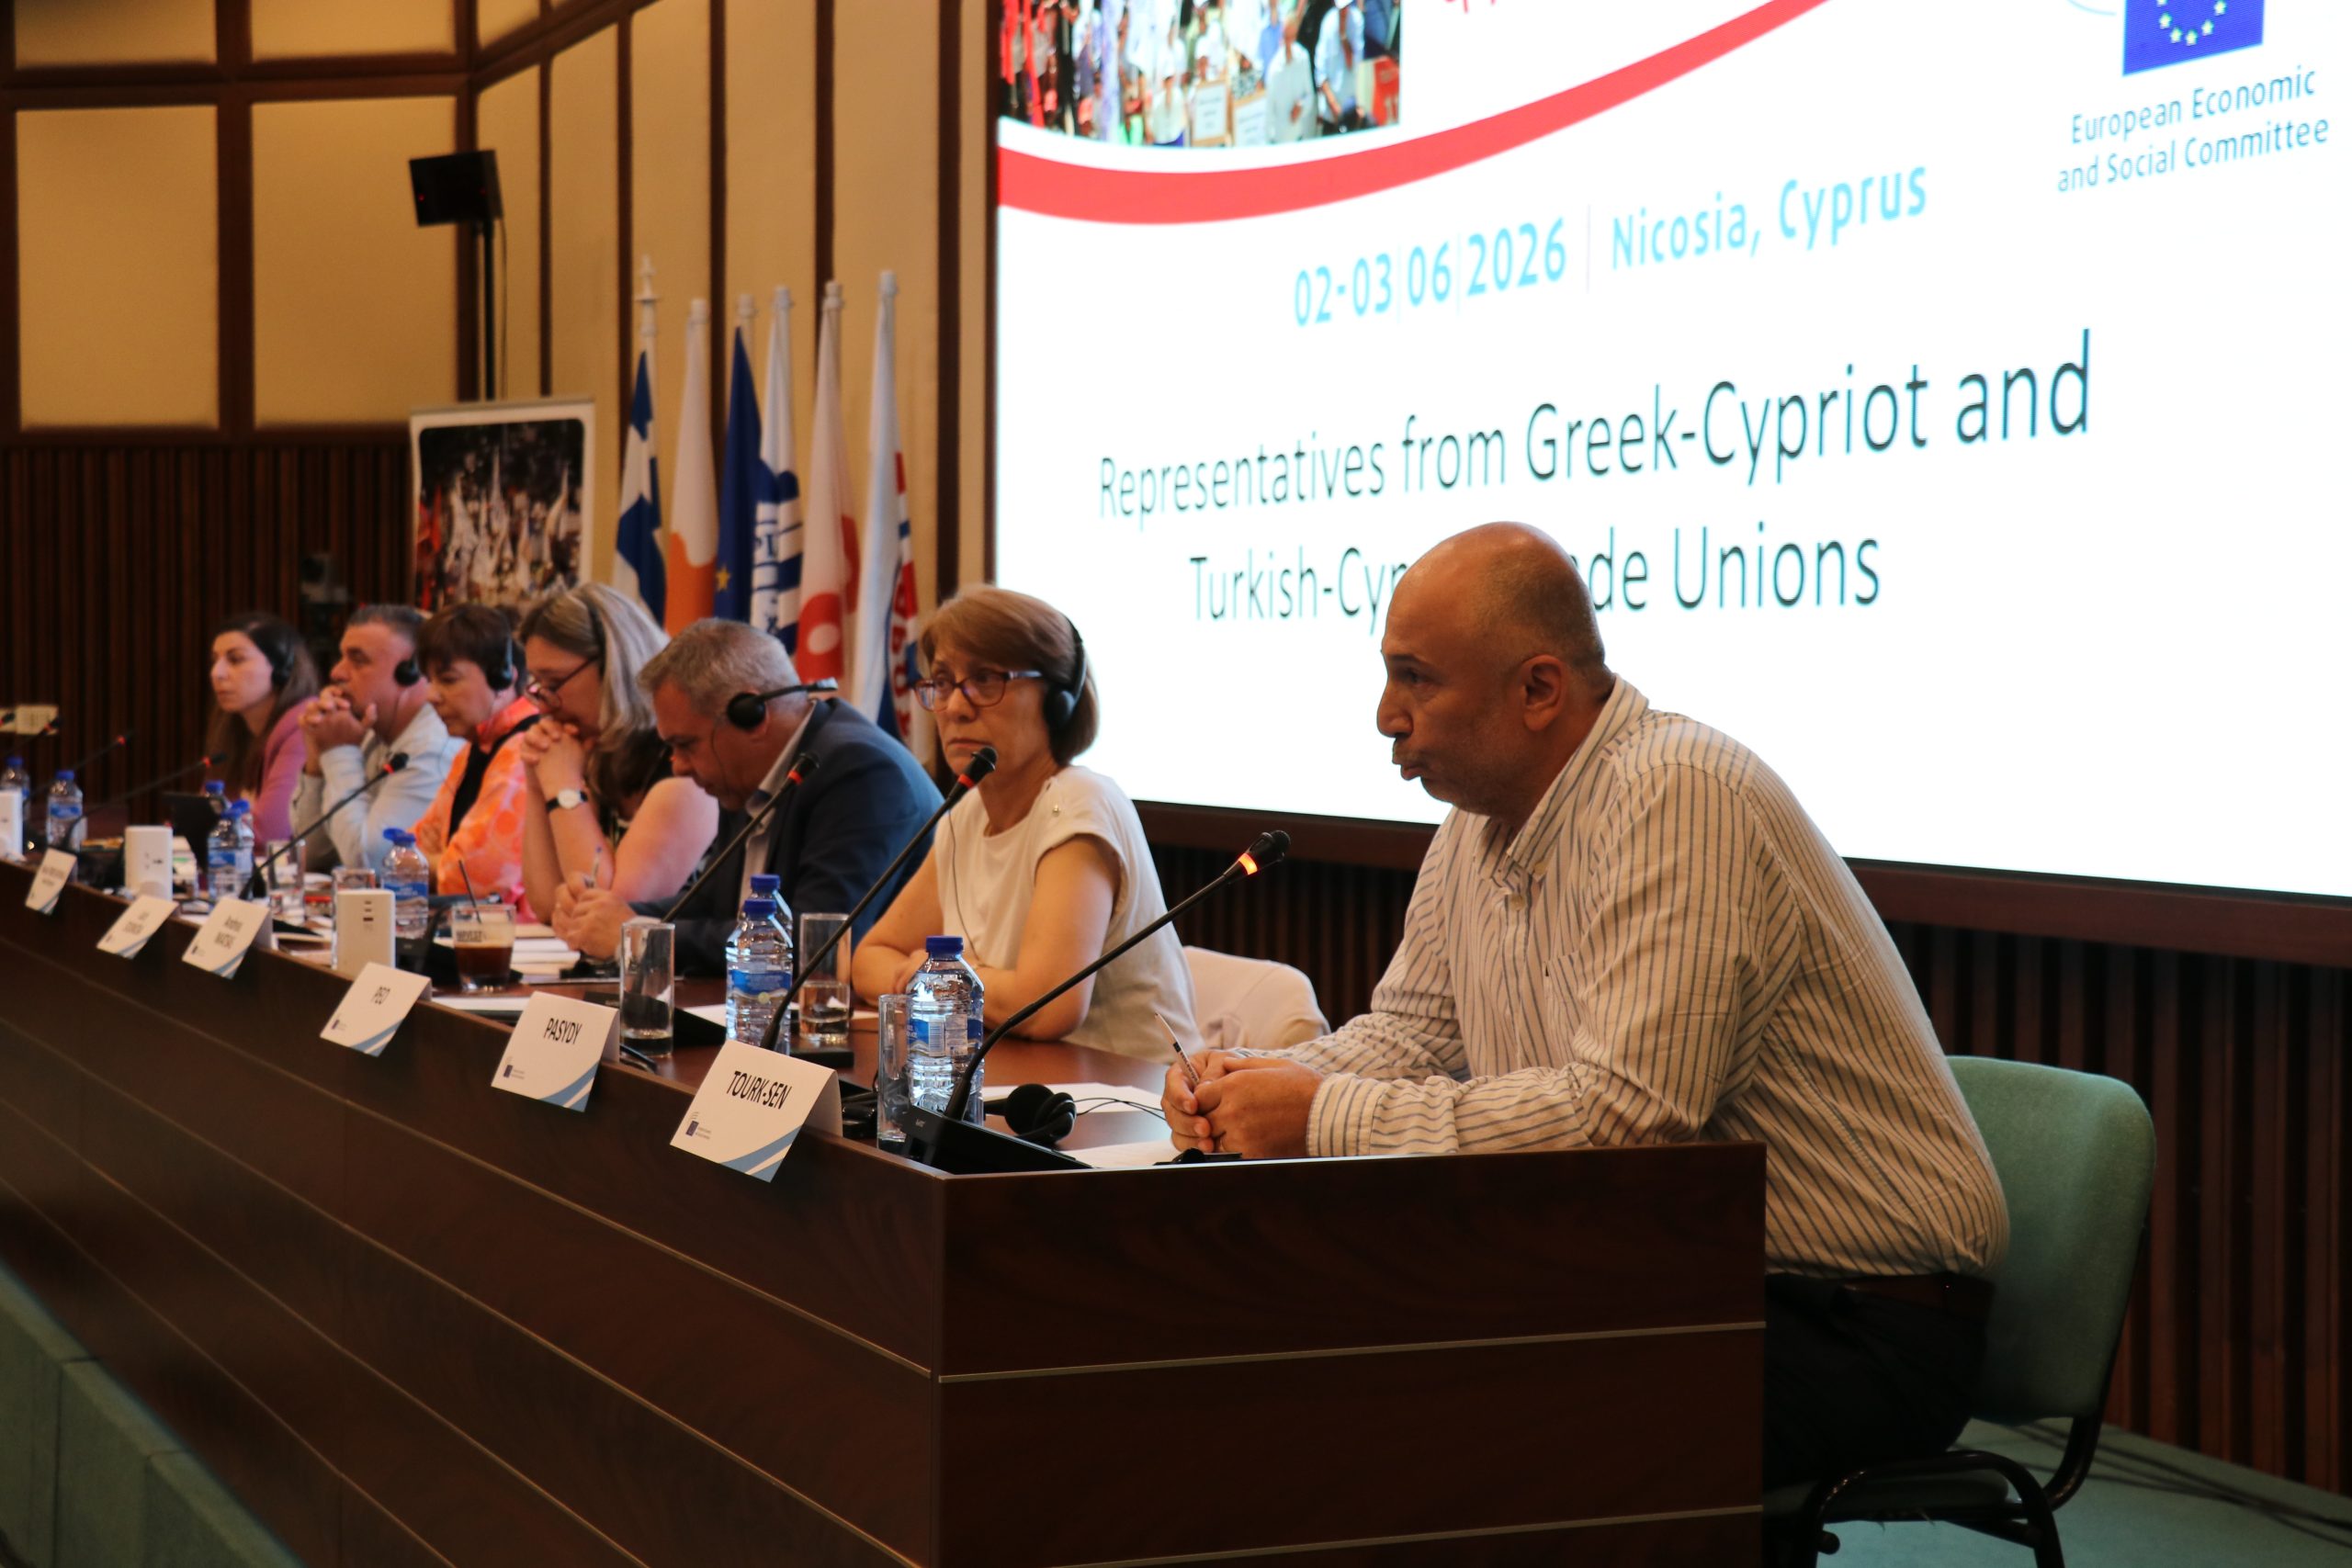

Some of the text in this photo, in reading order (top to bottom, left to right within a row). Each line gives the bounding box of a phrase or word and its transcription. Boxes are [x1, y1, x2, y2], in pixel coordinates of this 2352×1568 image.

[2072, 64, 2315, 144] European Economic
[2058, 119, 2329, 192] and Social Committee
[1613, 191, 1760, 269] Nicosia,
[1780, 166, 1926, 250] Cyprus
[1101, 327, 2091, 530] Representatives from Greek-Cypriot and
[1673, 520, 1881, 612] Unions
[543, 1017, 582, 1044] PASYDY
[726, 1070, 792, 1110] TOURK-SEN
